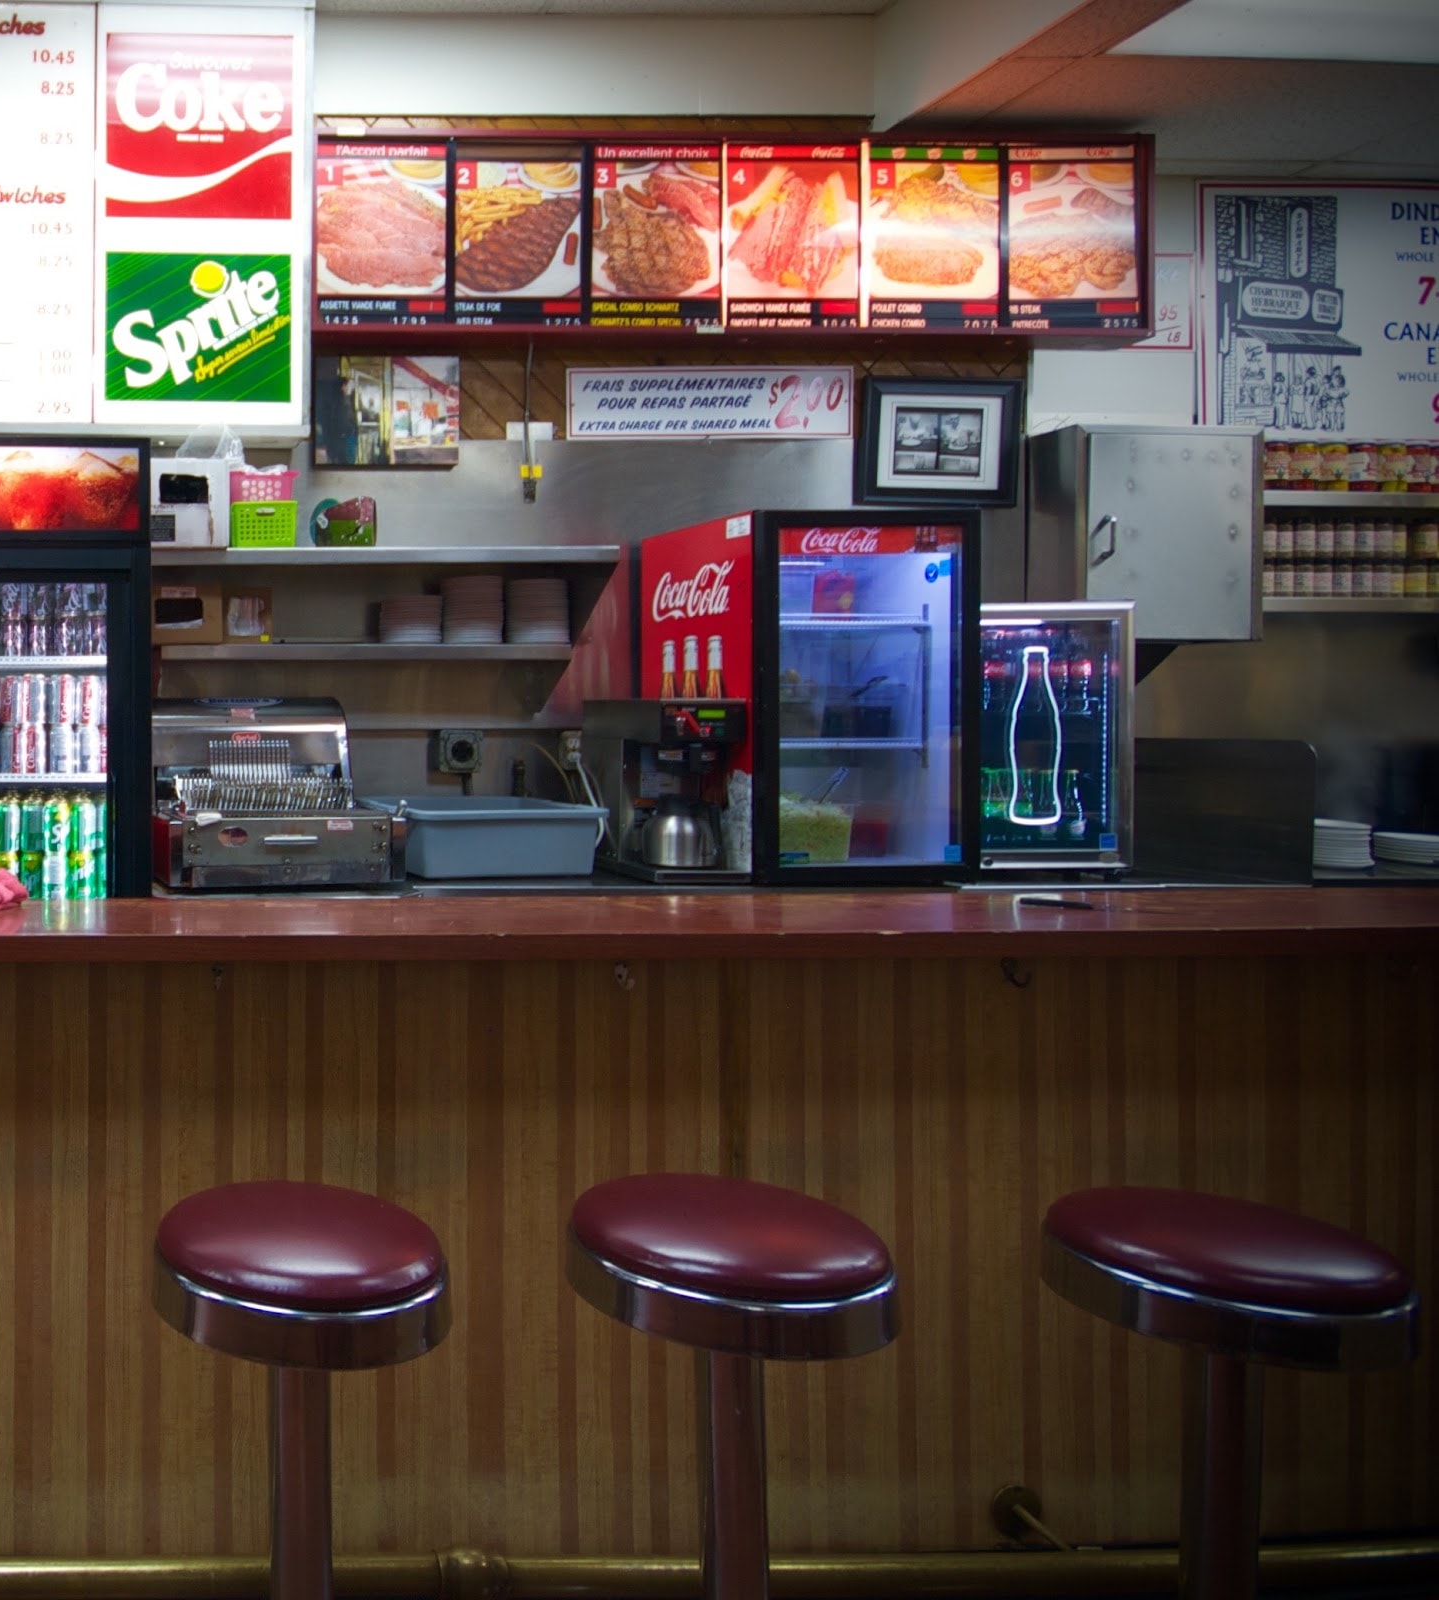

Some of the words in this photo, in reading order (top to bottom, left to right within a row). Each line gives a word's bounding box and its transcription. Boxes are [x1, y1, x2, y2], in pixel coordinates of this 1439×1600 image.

[31, 49, 74, 63] 10.45
[40, 81, 74, 95] 8.25
[116, 62, 284, 133] Coke
[40, 132, 72, 145] 8.25
[335, 144, 386, 157] l'Accord
[388, 144, 429, 157] parfait
[597, 147, 617, 159] Un
[618, 147, 673, 159] excellent
[675, 148, 709, 159] choix
[325, 165, 334, 182] 1
[458, 168, 470, 185] 2
[597, 168, 609, 183] 3
[732, 168, 746, 184] 4
[876, 169, 888, 185] 5
[1010, 171, 1023, 187] 6
[30, 221, 72, 234] 10.45
[1395, 251, 1434, 263] WHOLE
[112, 268, 281, 389] Sprite
[582, 379, 625, 393] FRAIS
[628, 377, 767, 393] SUPPLÉMENTAIRES
[1396, 372, 1438, 384] WHOLE
[37, 400, 70, 414] 2.95
[597, 397, 636, 410] POUR
[640, 397, 685, 409] REPAS
[689, 394, 753, 409] PARTAGÉ
[578, 421, 615, 431] EXTRA
[618, 420, 663, 431] CHARGE
[665, 420, 687, 430] PER
[691, 419, 738, 430] SHARED
[739, 419, 772, 429] MEAL
[801, 526, 881, 554] Coca-Cola
[653, 559, 735, 622] Coca-Cola
